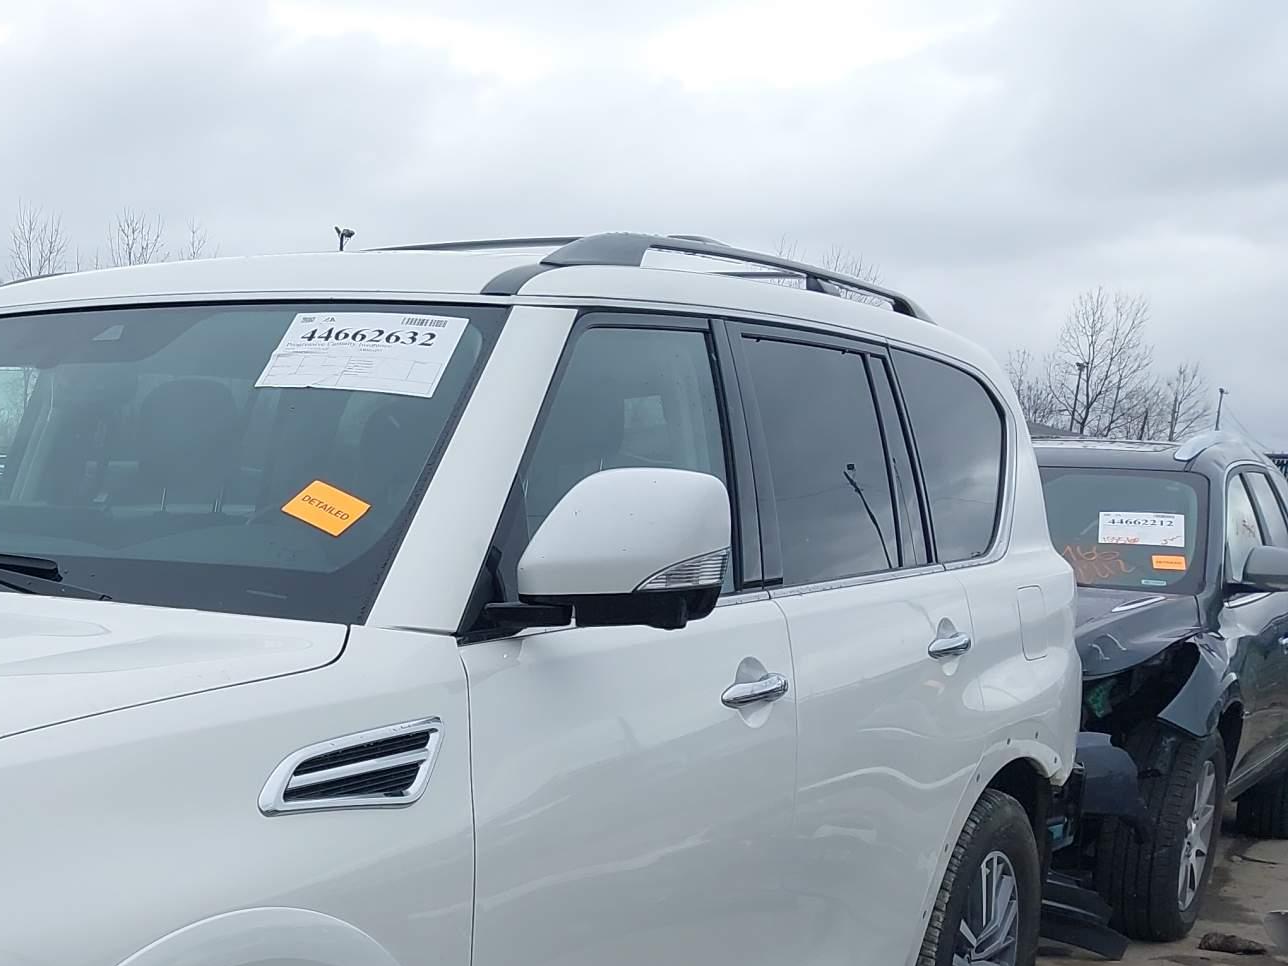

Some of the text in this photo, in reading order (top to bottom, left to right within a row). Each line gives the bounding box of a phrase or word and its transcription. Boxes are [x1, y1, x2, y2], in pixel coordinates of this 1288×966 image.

[301, 327, 437, 347] 44662632
[302, 494, 350, 521] DETAILED
[1107, 518, 1174, 527] 44662212
